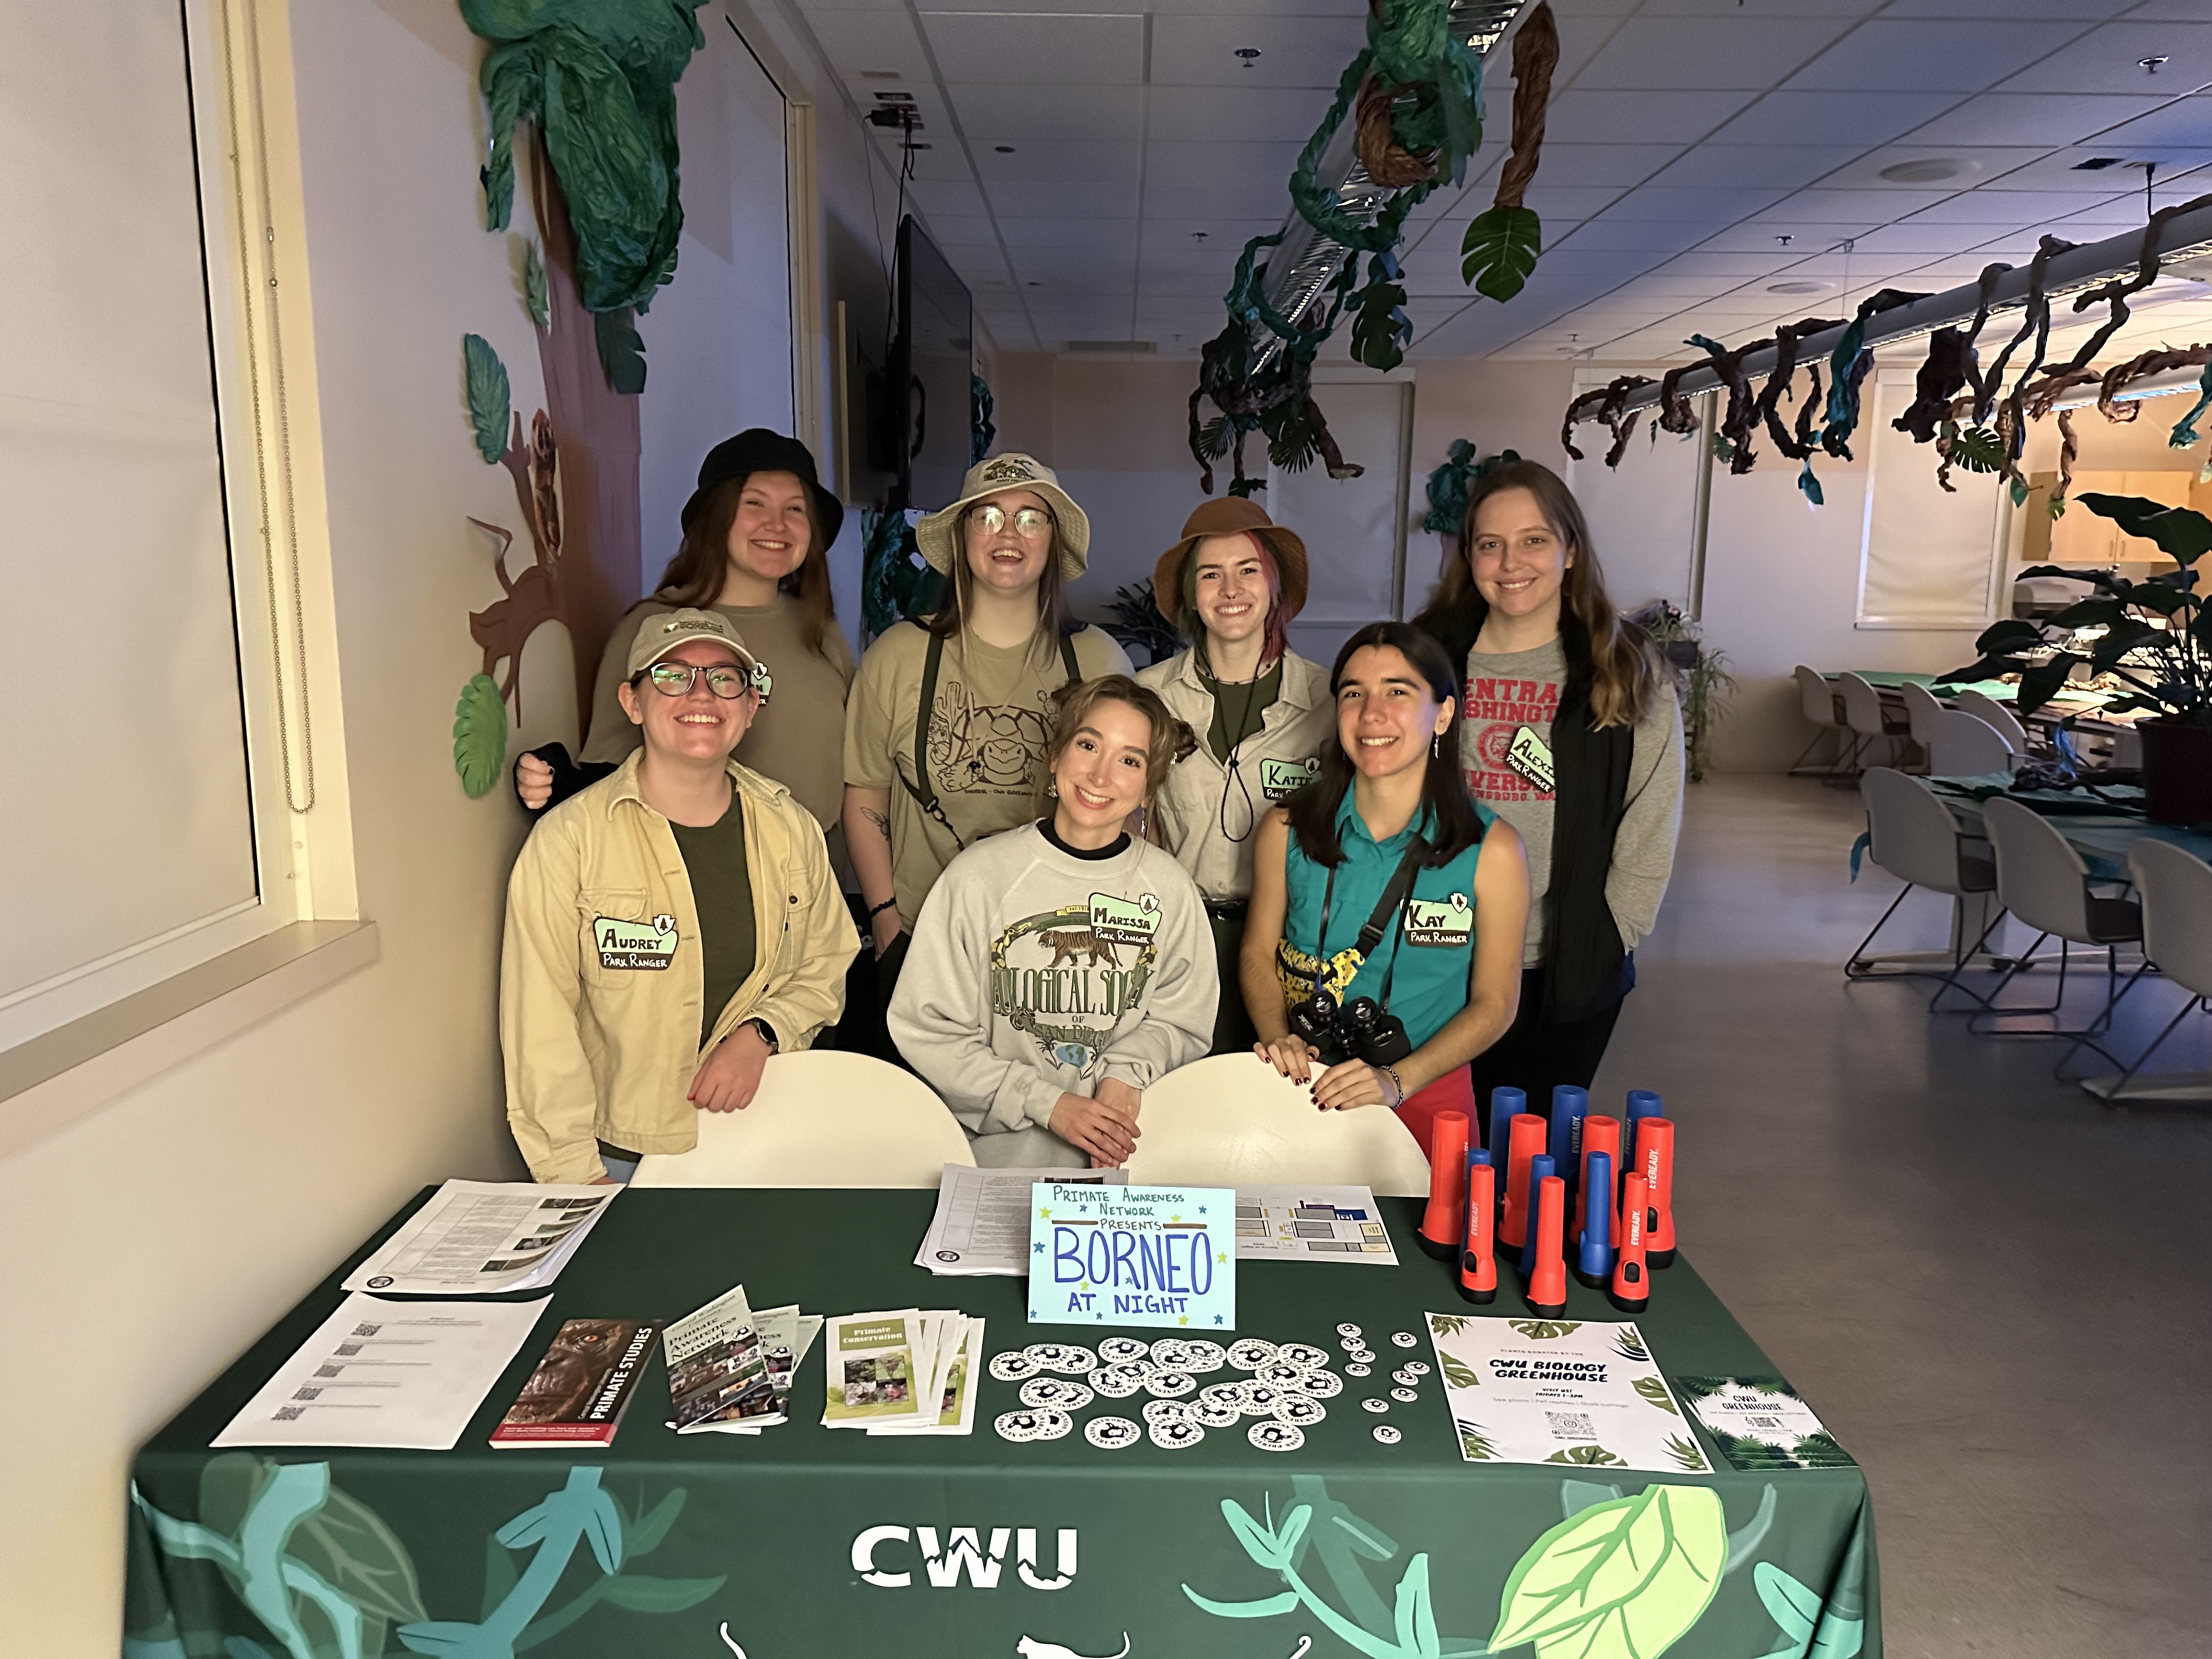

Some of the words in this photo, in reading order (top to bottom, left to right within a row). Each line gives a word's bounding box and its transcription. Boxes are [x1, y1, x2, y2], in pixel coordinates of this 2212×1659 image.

[1466, 678, 1558, 703] ENTRA
[1465, 700, 1560, 723] SHINGT
[1506, 754, 1521, 772] PARK
[1521, 765, 1550, 792] RANGER
[1267, 788, 1283, 799] PARK
[1093, 907, 1151, 930] MARISSA
[1408, 905, 1447, 929] KAY
[602, 928, 662, 950] AUDREY
[1095, 928, 1115, 941] PARK
[1117, 929, 1150, 945] RANGER
[1410, 932, 1431, 943] PARK
[1432, 932, 1468, 944] RANGER
[603, 953, 628, 967] PARK
[630, 953, 668, 968] RANGER
[1071, 1015, 1085, 1024] OF
[1034, 1024, 1068, 1041] SAN
[1053, 1185, 1110, 1202] PRIMATE
[1122, 1187, 1185, 1203] AWARENESS
[1099, 1203, 1155, 1216] NETWORK
[1100, 1220, 1163, 1231] PRESENTS
[1054, 1227, 1212, 1295] BORNEO
[1067, 1292, 1097, 1312] AT
[1114, 1294, 1188, 1314] NIGHT
[669, 1317, 720, 1346] Primate
[670, 1316, 737, 1353] Awareness
[843, 1332, 902, 1344] Conservation
[854, 1326, 891, 1336] Primate
[672, 1328, 730, 1362] Network
[589, 1371, 630, 1420] PRIMATE
[618, 1328, 653, 1369] STUDIES
[1489, 1359, 1527, 1369] CWU
[1533, 1361, 1606, 1373] BIOLOGY
[1495, 1369, 1609, 1383] GREENHOUSE
[1722, 1402, 1785, 1410] GREENHOUSE
[851, 1525, 1077, 1590] CWU
